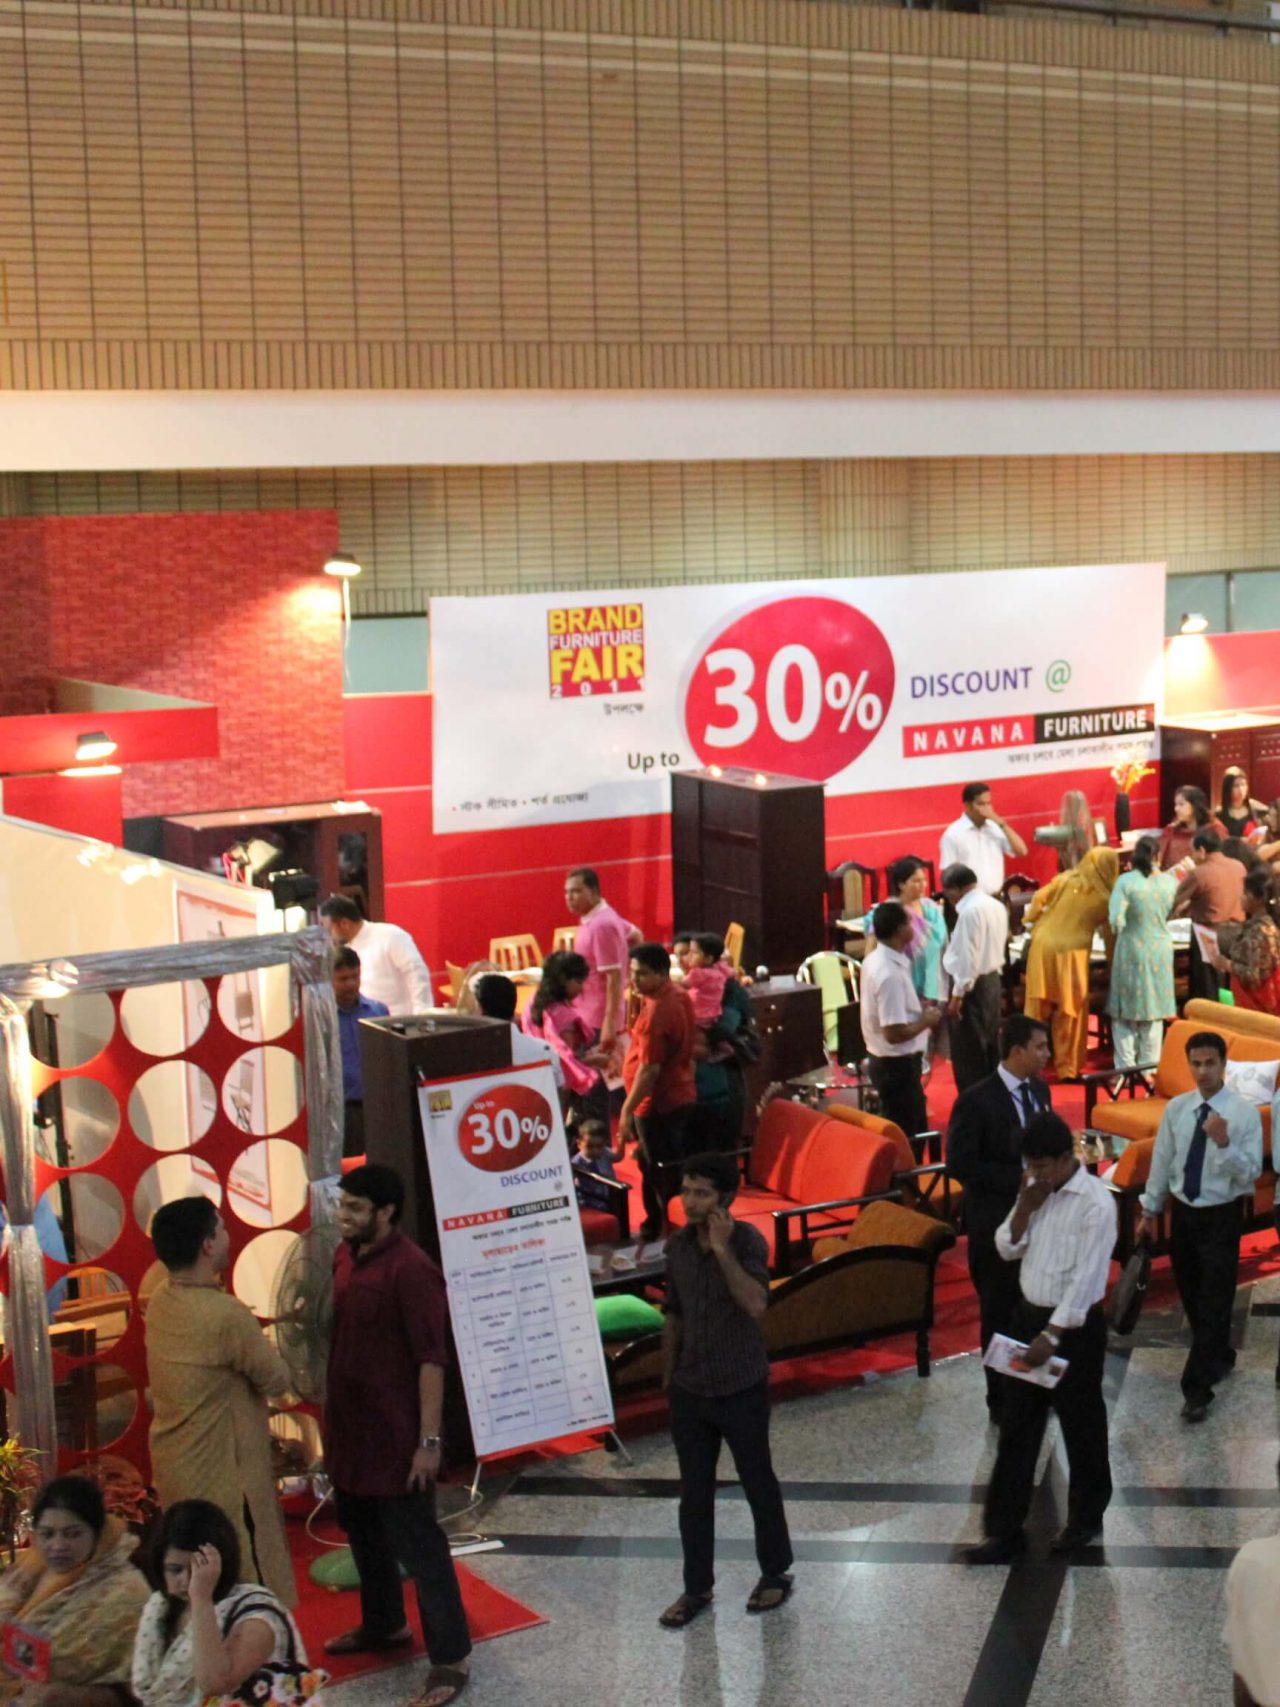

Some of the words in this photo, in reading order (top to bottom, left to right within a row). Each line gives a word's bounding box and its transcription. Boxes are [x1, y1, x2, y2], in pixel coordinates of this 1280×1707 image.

[549, 604, 643, 635] BRAND
[549, 629, 643, 650] FURNITURE
[550, 644, 645, 685] FAIR
[911, 666, 1033, 699] DISCOUNT
[1045, 659, 1073, 694] @
[551, 679, 645, 698] 2011
[703, 643, 884, 749] 30%
[912, 721, 1024, 753] NAVANA
[1043, 708, 1148, 738] FURNITURE
[627, 753, 655, 772] Up
[660, 752, 680, 768] to
[467, 1107, 550, 1155] 30%
[500, 1165, 563, 1188] DISCOUNT
[446, 1209, 505, 1230] NAVANA
[511, 1197, 566, 1217] FURNITURE
